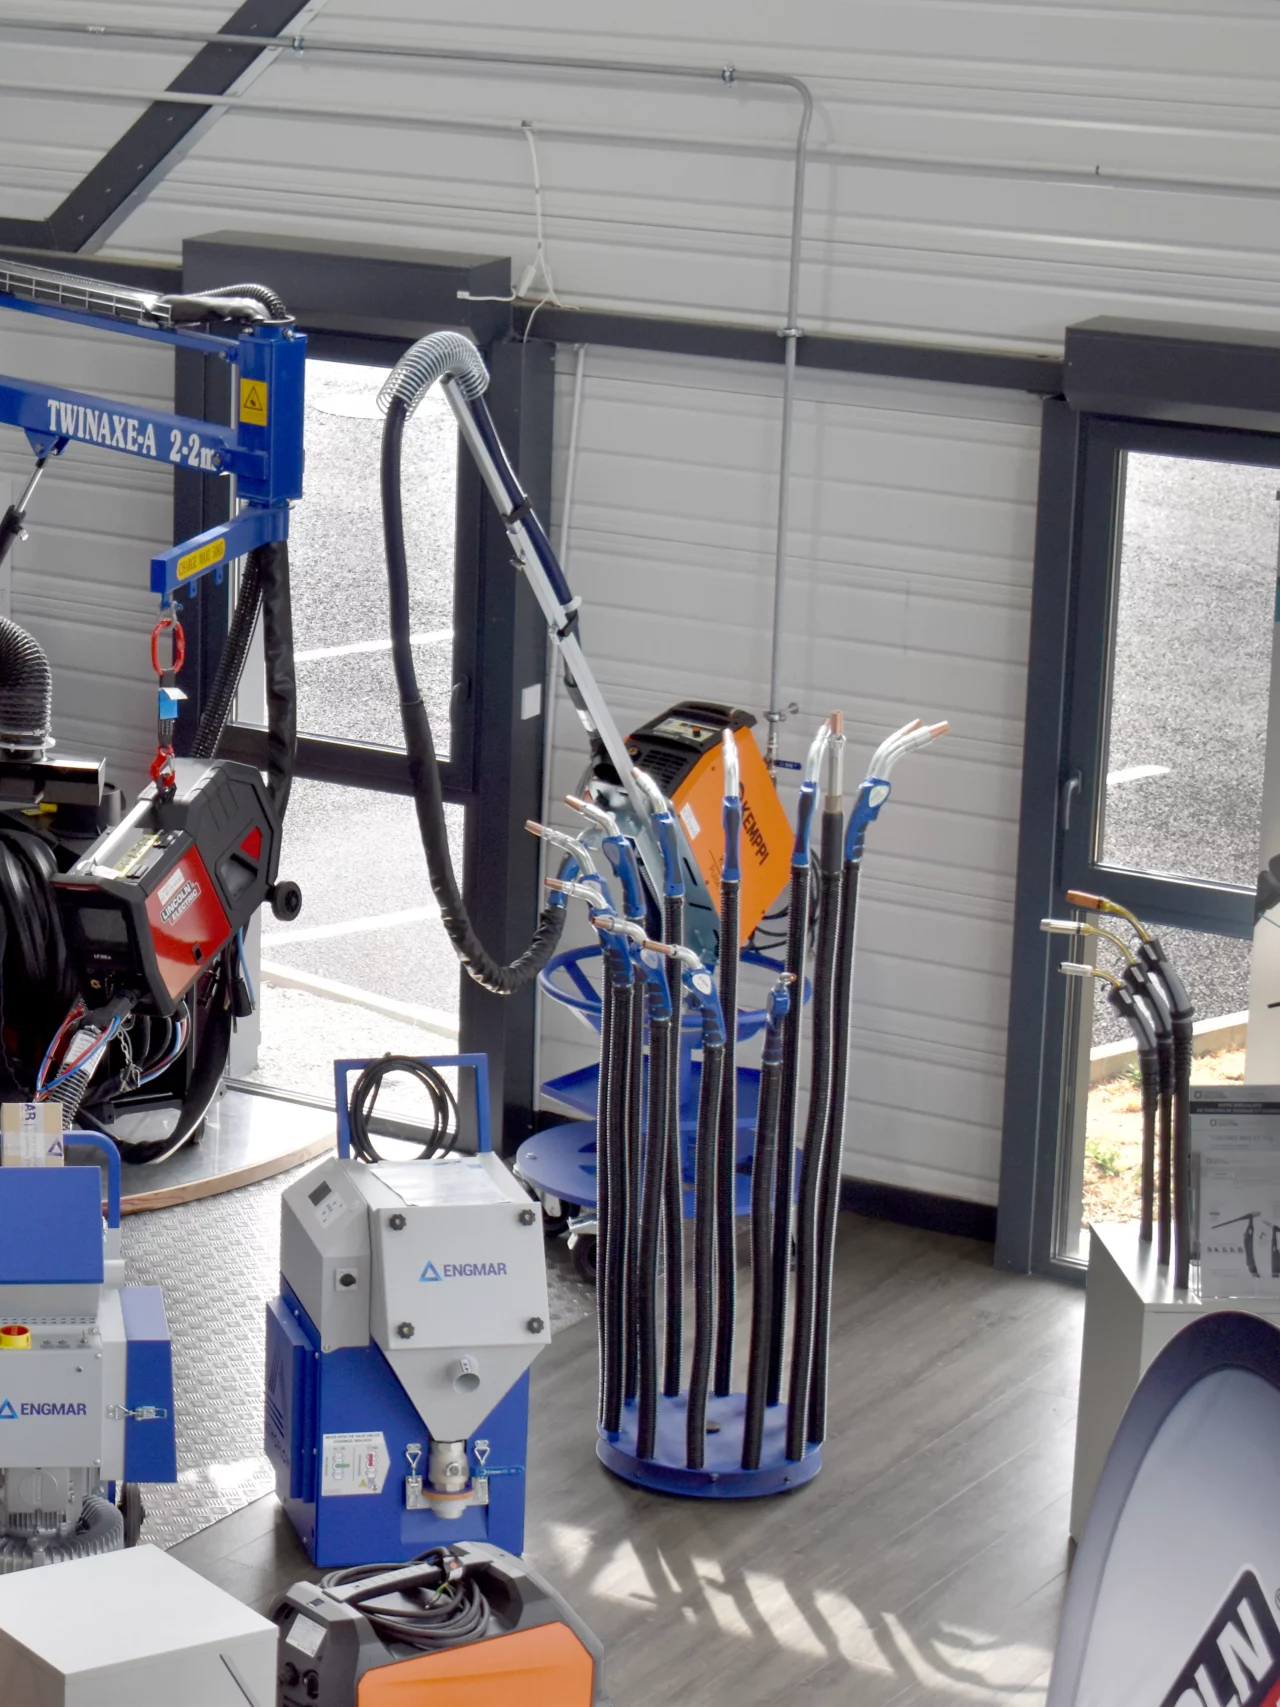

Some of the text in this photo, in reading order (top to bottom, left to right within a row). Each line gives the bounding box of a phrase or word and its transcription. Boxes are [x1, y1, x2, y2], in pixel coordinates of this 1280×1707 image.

[47, 398, 157, 457] TWINAXE-A
[741, 800, 770, 866] KEMPPI
[162, 882, 192, 920] LINCOLN
[172, 889, 198, 922] ELECTRIC
[443, 1261, 508, 1278] ENGMAR
[20, 1402, 87, 1416] ENGMAR
